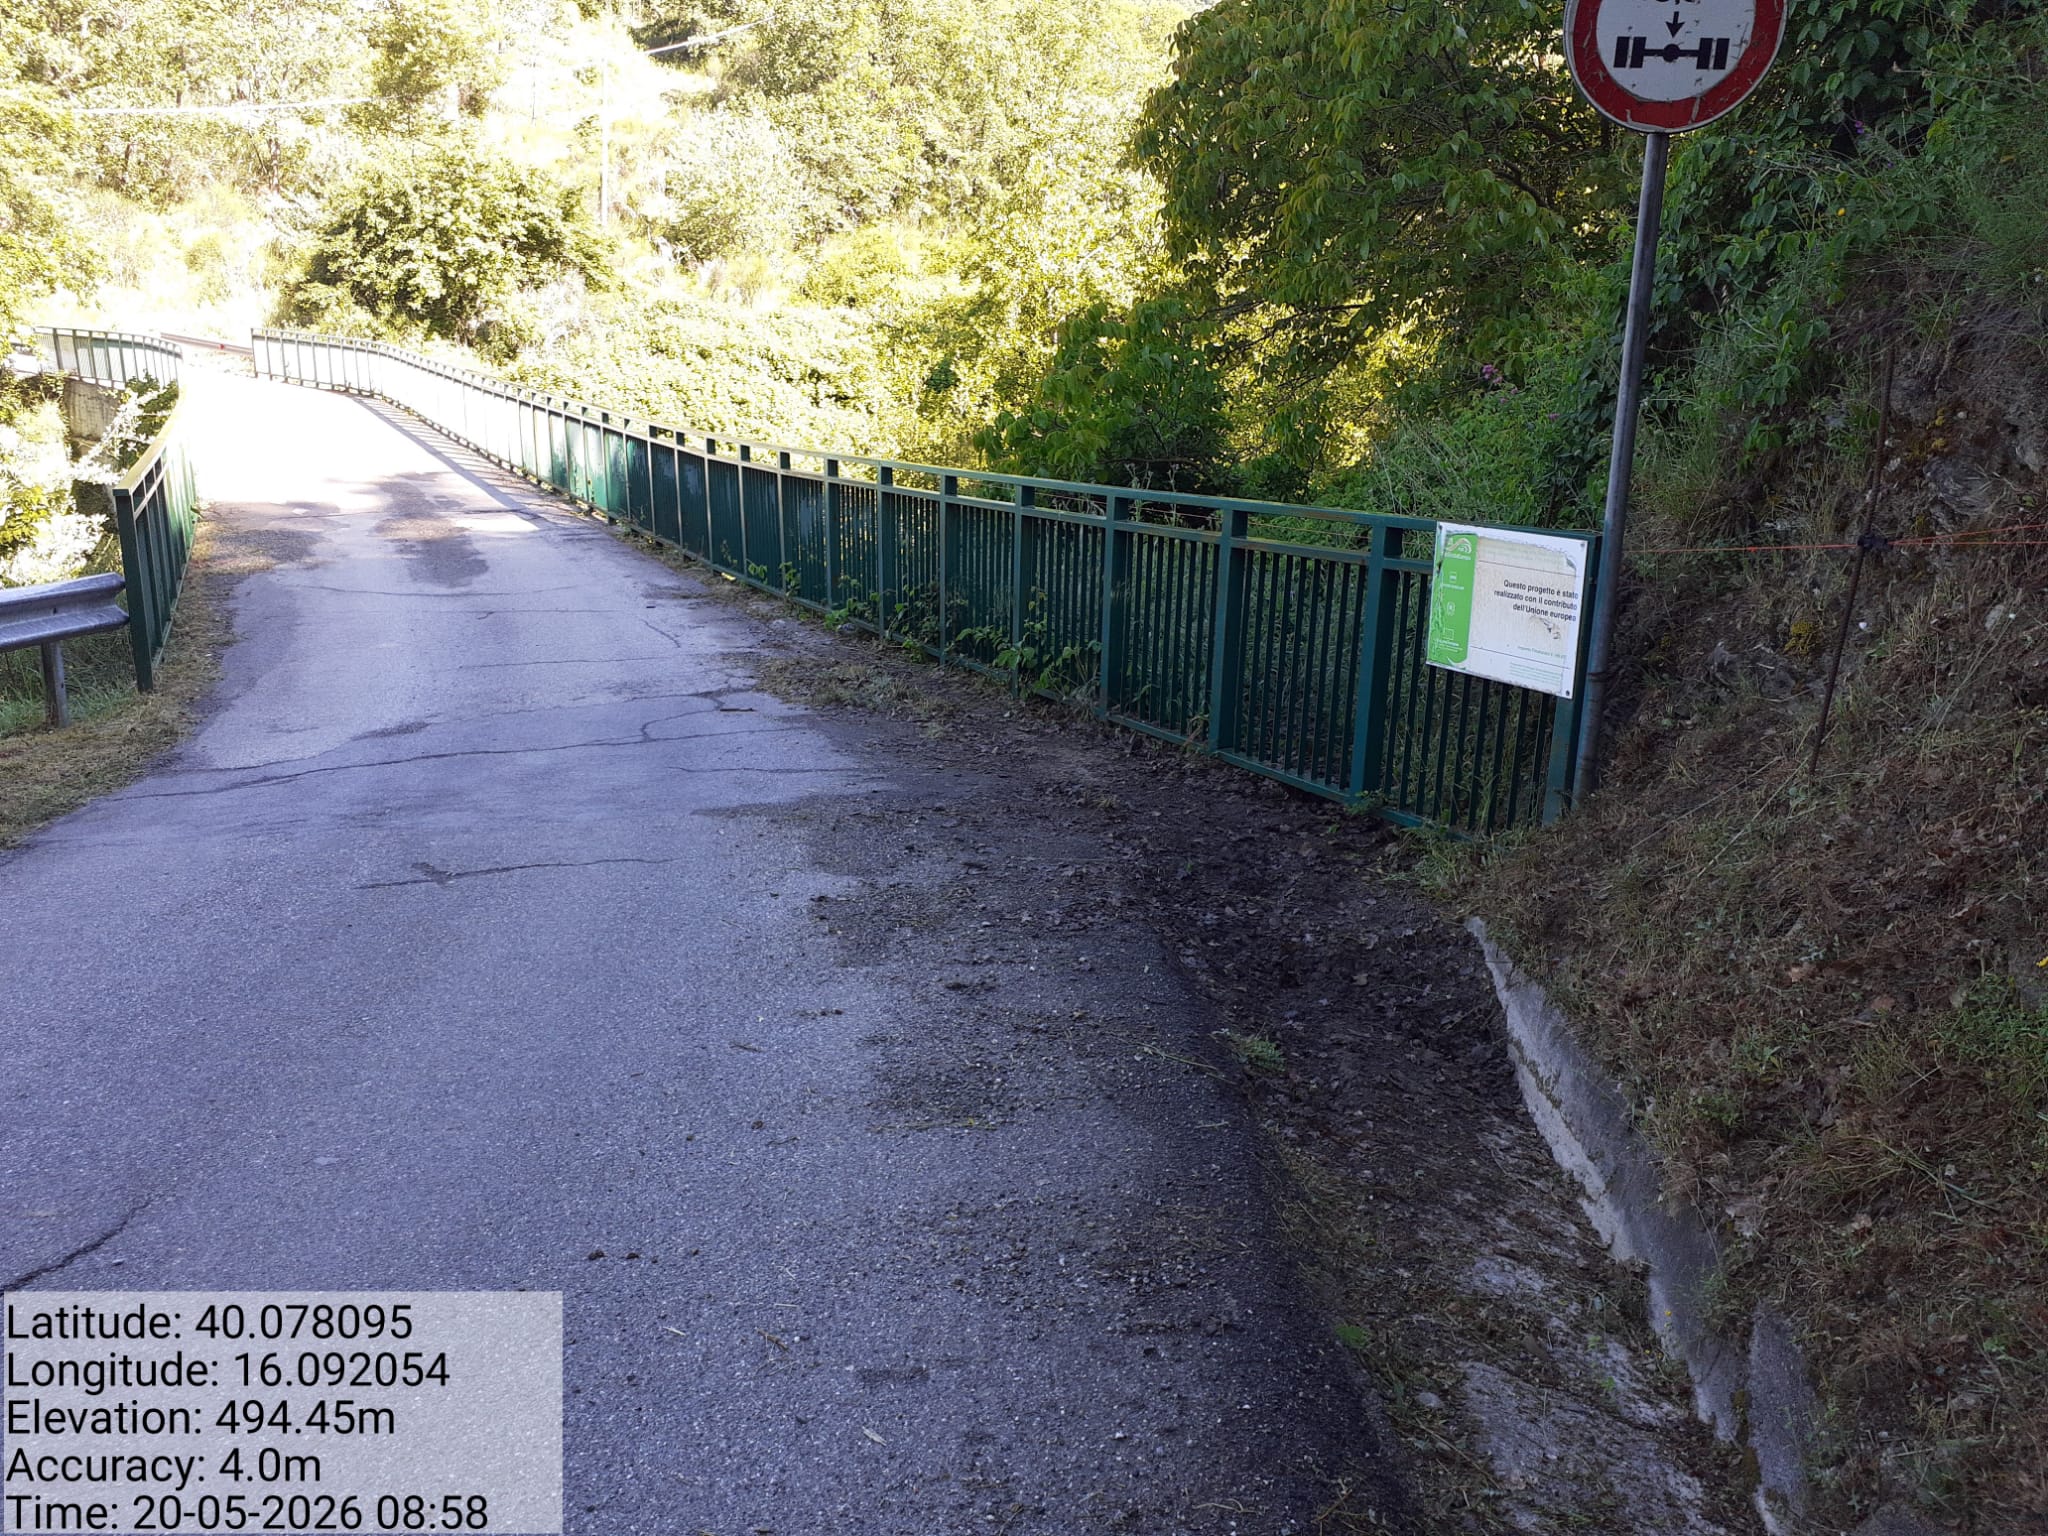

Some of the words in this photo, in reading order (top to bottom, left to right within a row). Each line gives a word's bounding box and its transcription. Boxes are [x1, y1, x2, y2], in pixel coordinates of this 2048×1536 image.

[1503, 579, 1527, 590] Questo
[1527, 584, 1555, 595] progetto
[1562, 590, 1579, 599] stato
[1494, 589, 1524, 600] realizzato
[1524, 595, 1537, 603] con
[1538, 596, 1543, 604] il
[1543, 598, 1578, 611] contributo
[1512, 602, 1549, 617] dell'Unione
[1549, 611, 1577, 622] europea
